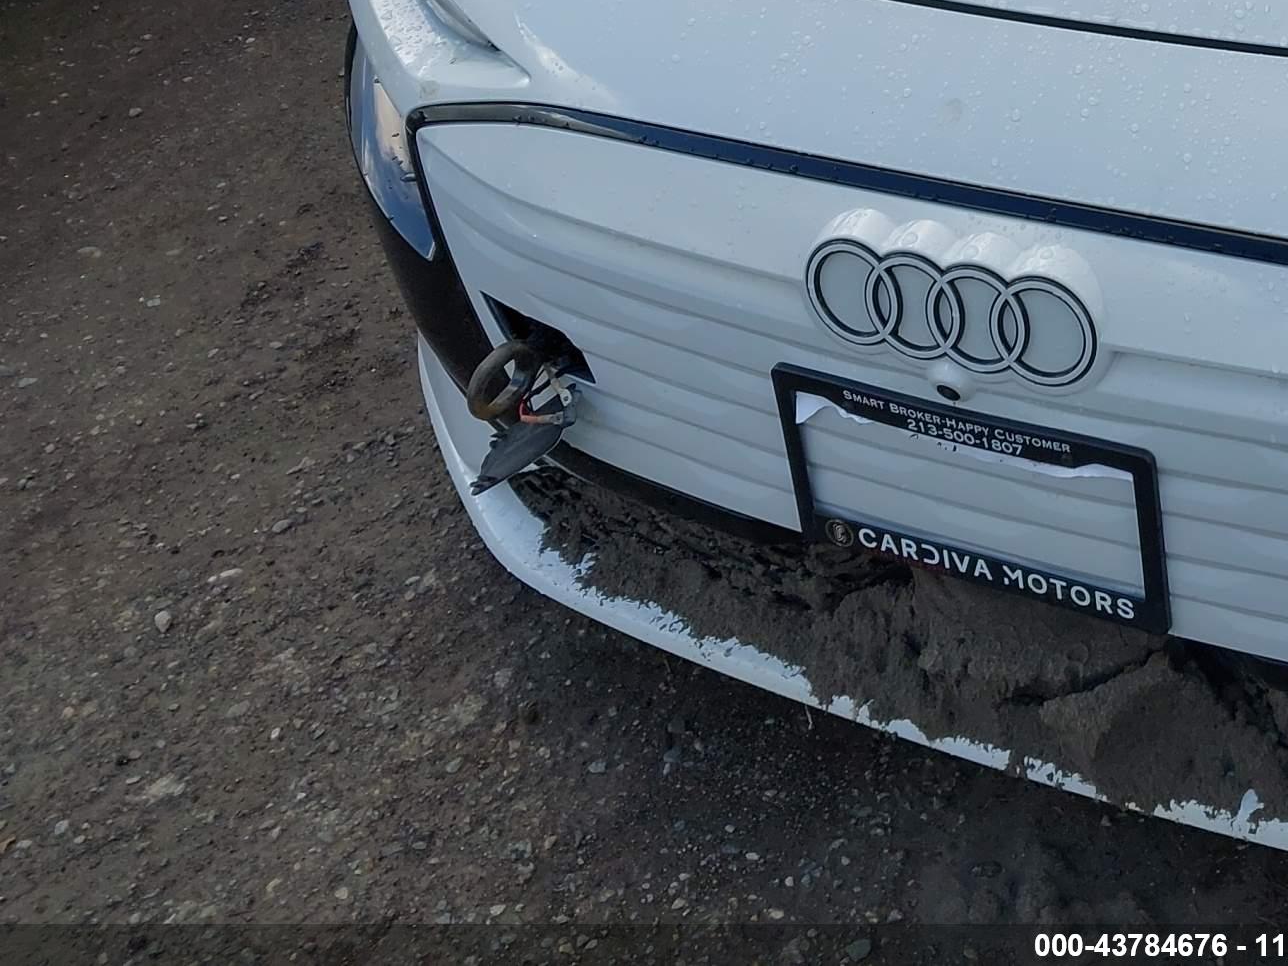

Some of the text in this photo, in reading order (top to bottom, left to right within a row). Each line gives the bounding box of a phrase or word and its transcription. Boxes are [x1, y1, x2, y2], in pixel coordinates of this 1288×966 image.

[842, 389, 1071, 454] SMART BROKER-HAPPY CUSTOMER
[906, 418, 1023, 456] 213-500-1807
[858, 528, 1136, 620] CARDIVA MOTORS
